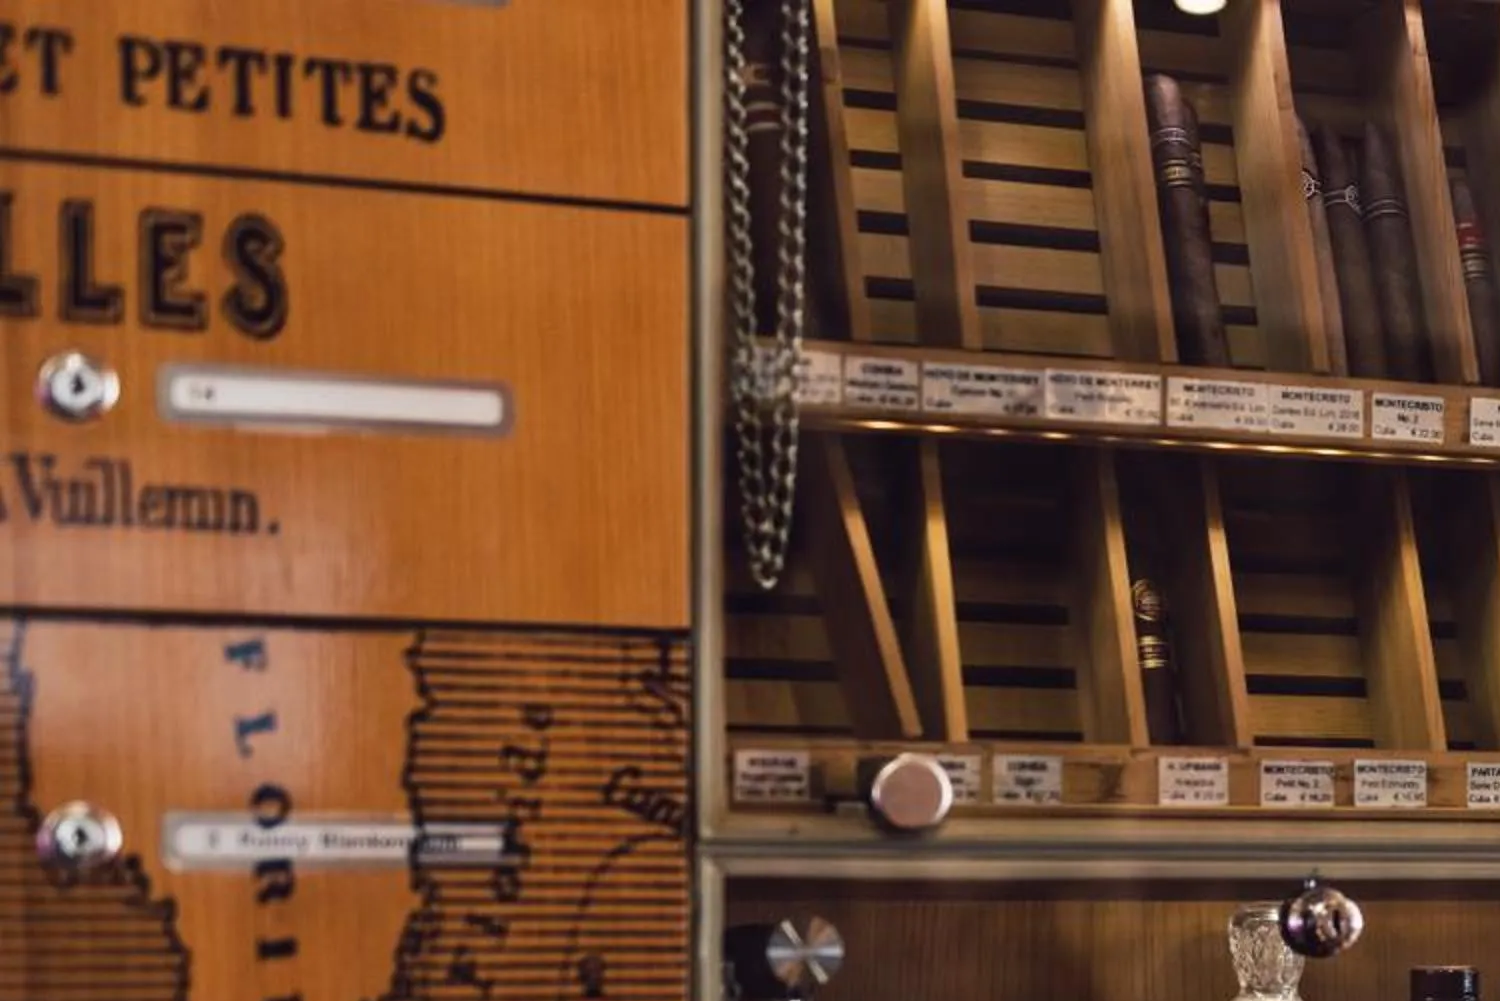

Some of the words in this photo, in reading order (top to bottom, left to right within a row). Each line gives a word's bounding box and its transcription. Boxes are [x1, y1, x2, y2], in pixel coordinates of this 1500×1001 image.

[118, 36, 446, 144] PETITES
[1183, 383, 1255, 397] MONTECRISTO
[1280, 390, 1351, 404] MONTECRISTO
[1374, 399, 1444, 413] MONTECRISTO
[1263, 765, 1334, 776] MONTECRISTO
[1357, 765, 1425, 776] MONTECRISTO
[1469, 793, 1491, 803] Cuba
